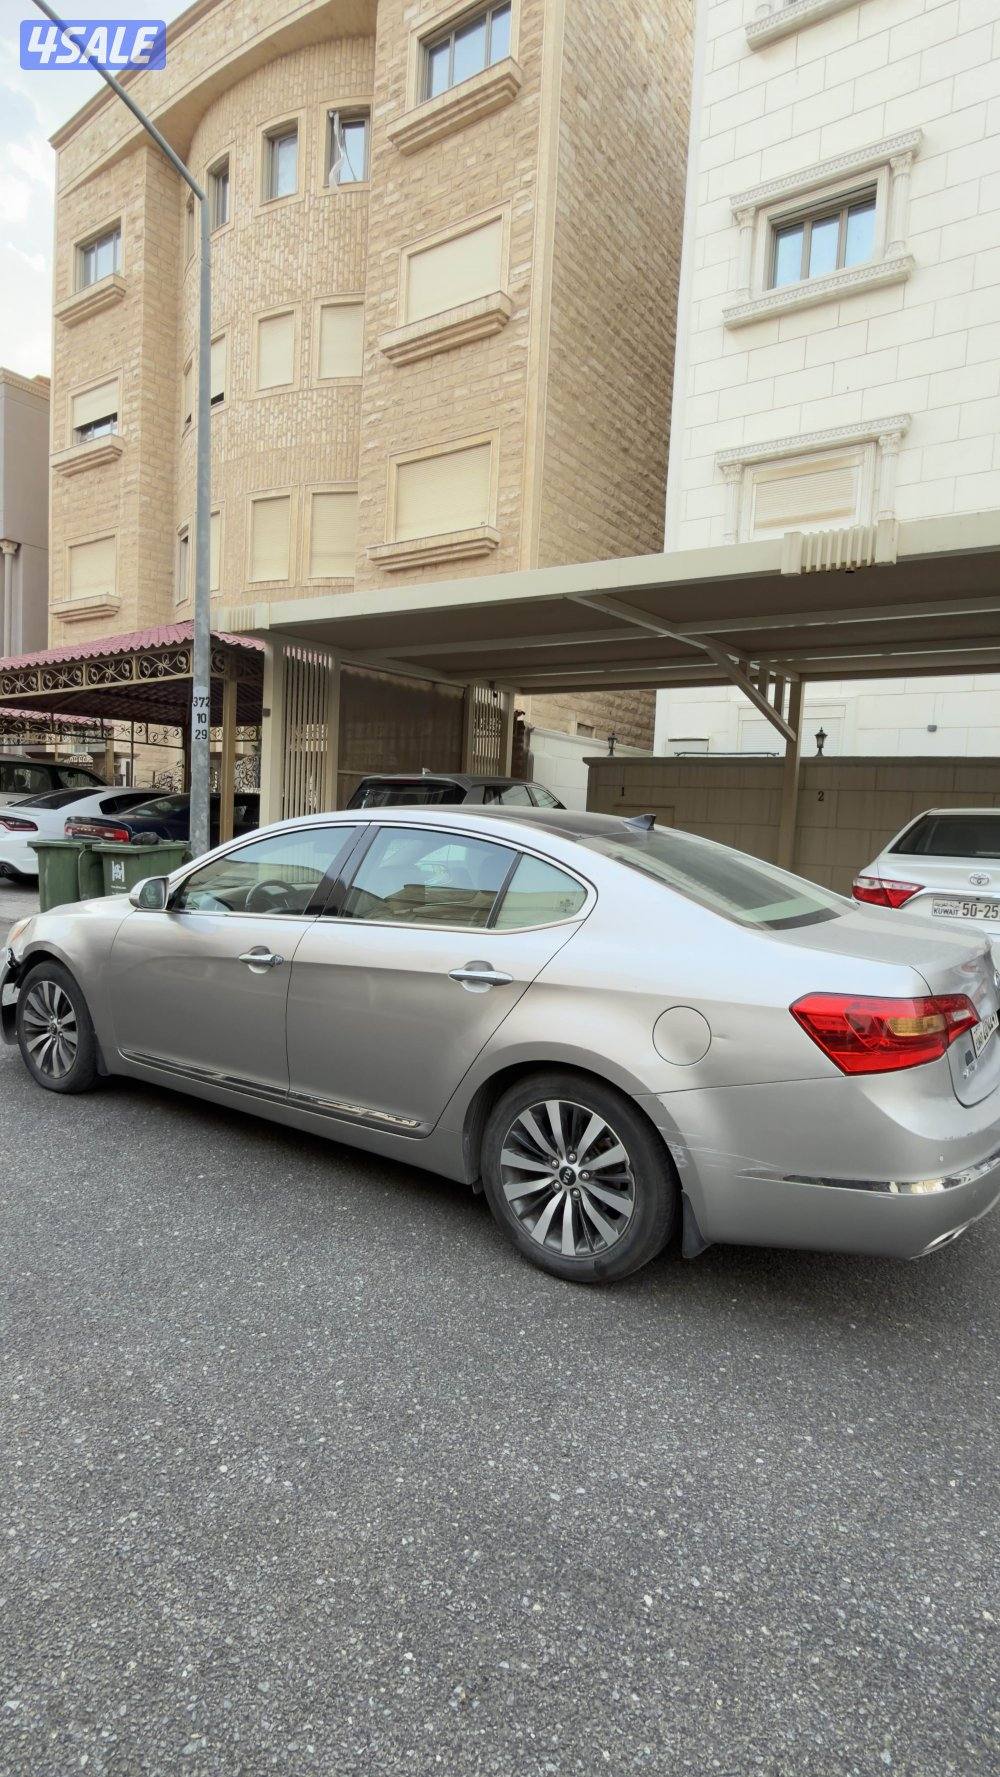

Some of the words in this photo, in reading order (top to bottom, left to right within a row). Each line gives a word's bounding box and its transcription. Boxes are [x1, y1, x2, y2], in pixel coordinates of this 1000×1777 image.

[193, 697, 210, 707] 372
[197, 713, 206, 723] 10
[195, 730, 207, 739] 29
[817, 790, 824, 802] 2
[933, 908, 959, 916] KUWAIT
